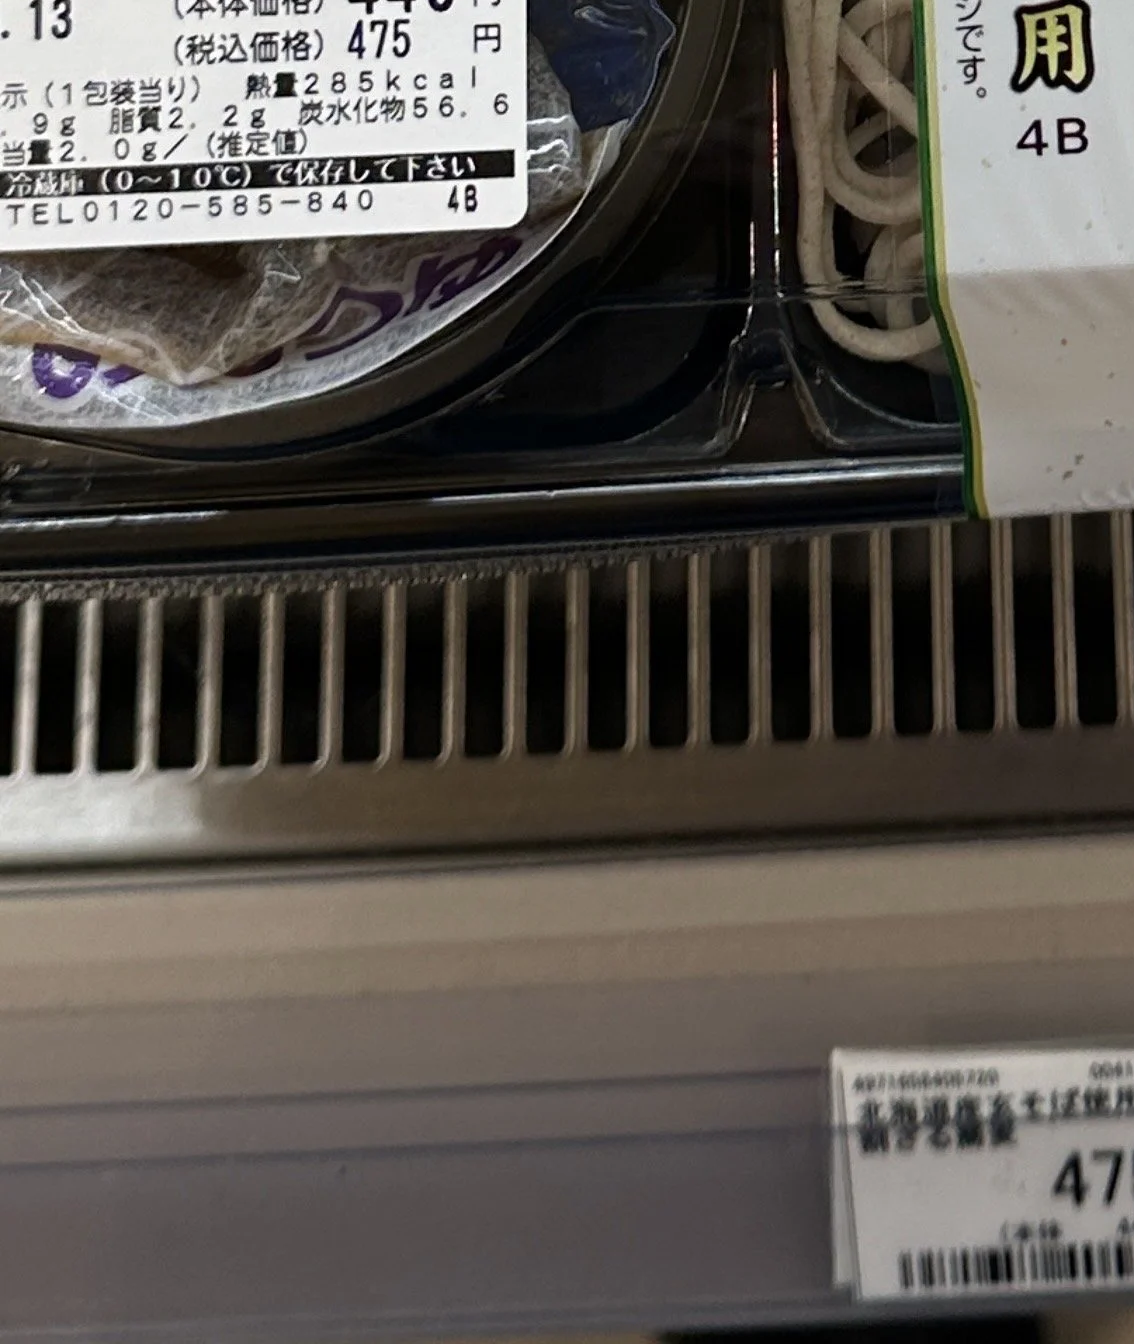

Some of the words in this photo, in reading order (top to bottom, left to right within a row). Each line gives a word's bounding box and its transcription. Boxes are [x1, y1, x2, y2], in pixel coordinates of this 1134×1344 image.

[347, 18, 412, 60] 475
[474, 24, 501, 53] 円
[1016, 119, 1090, 157] 4B
[448, 186, 478, 213] 4B
